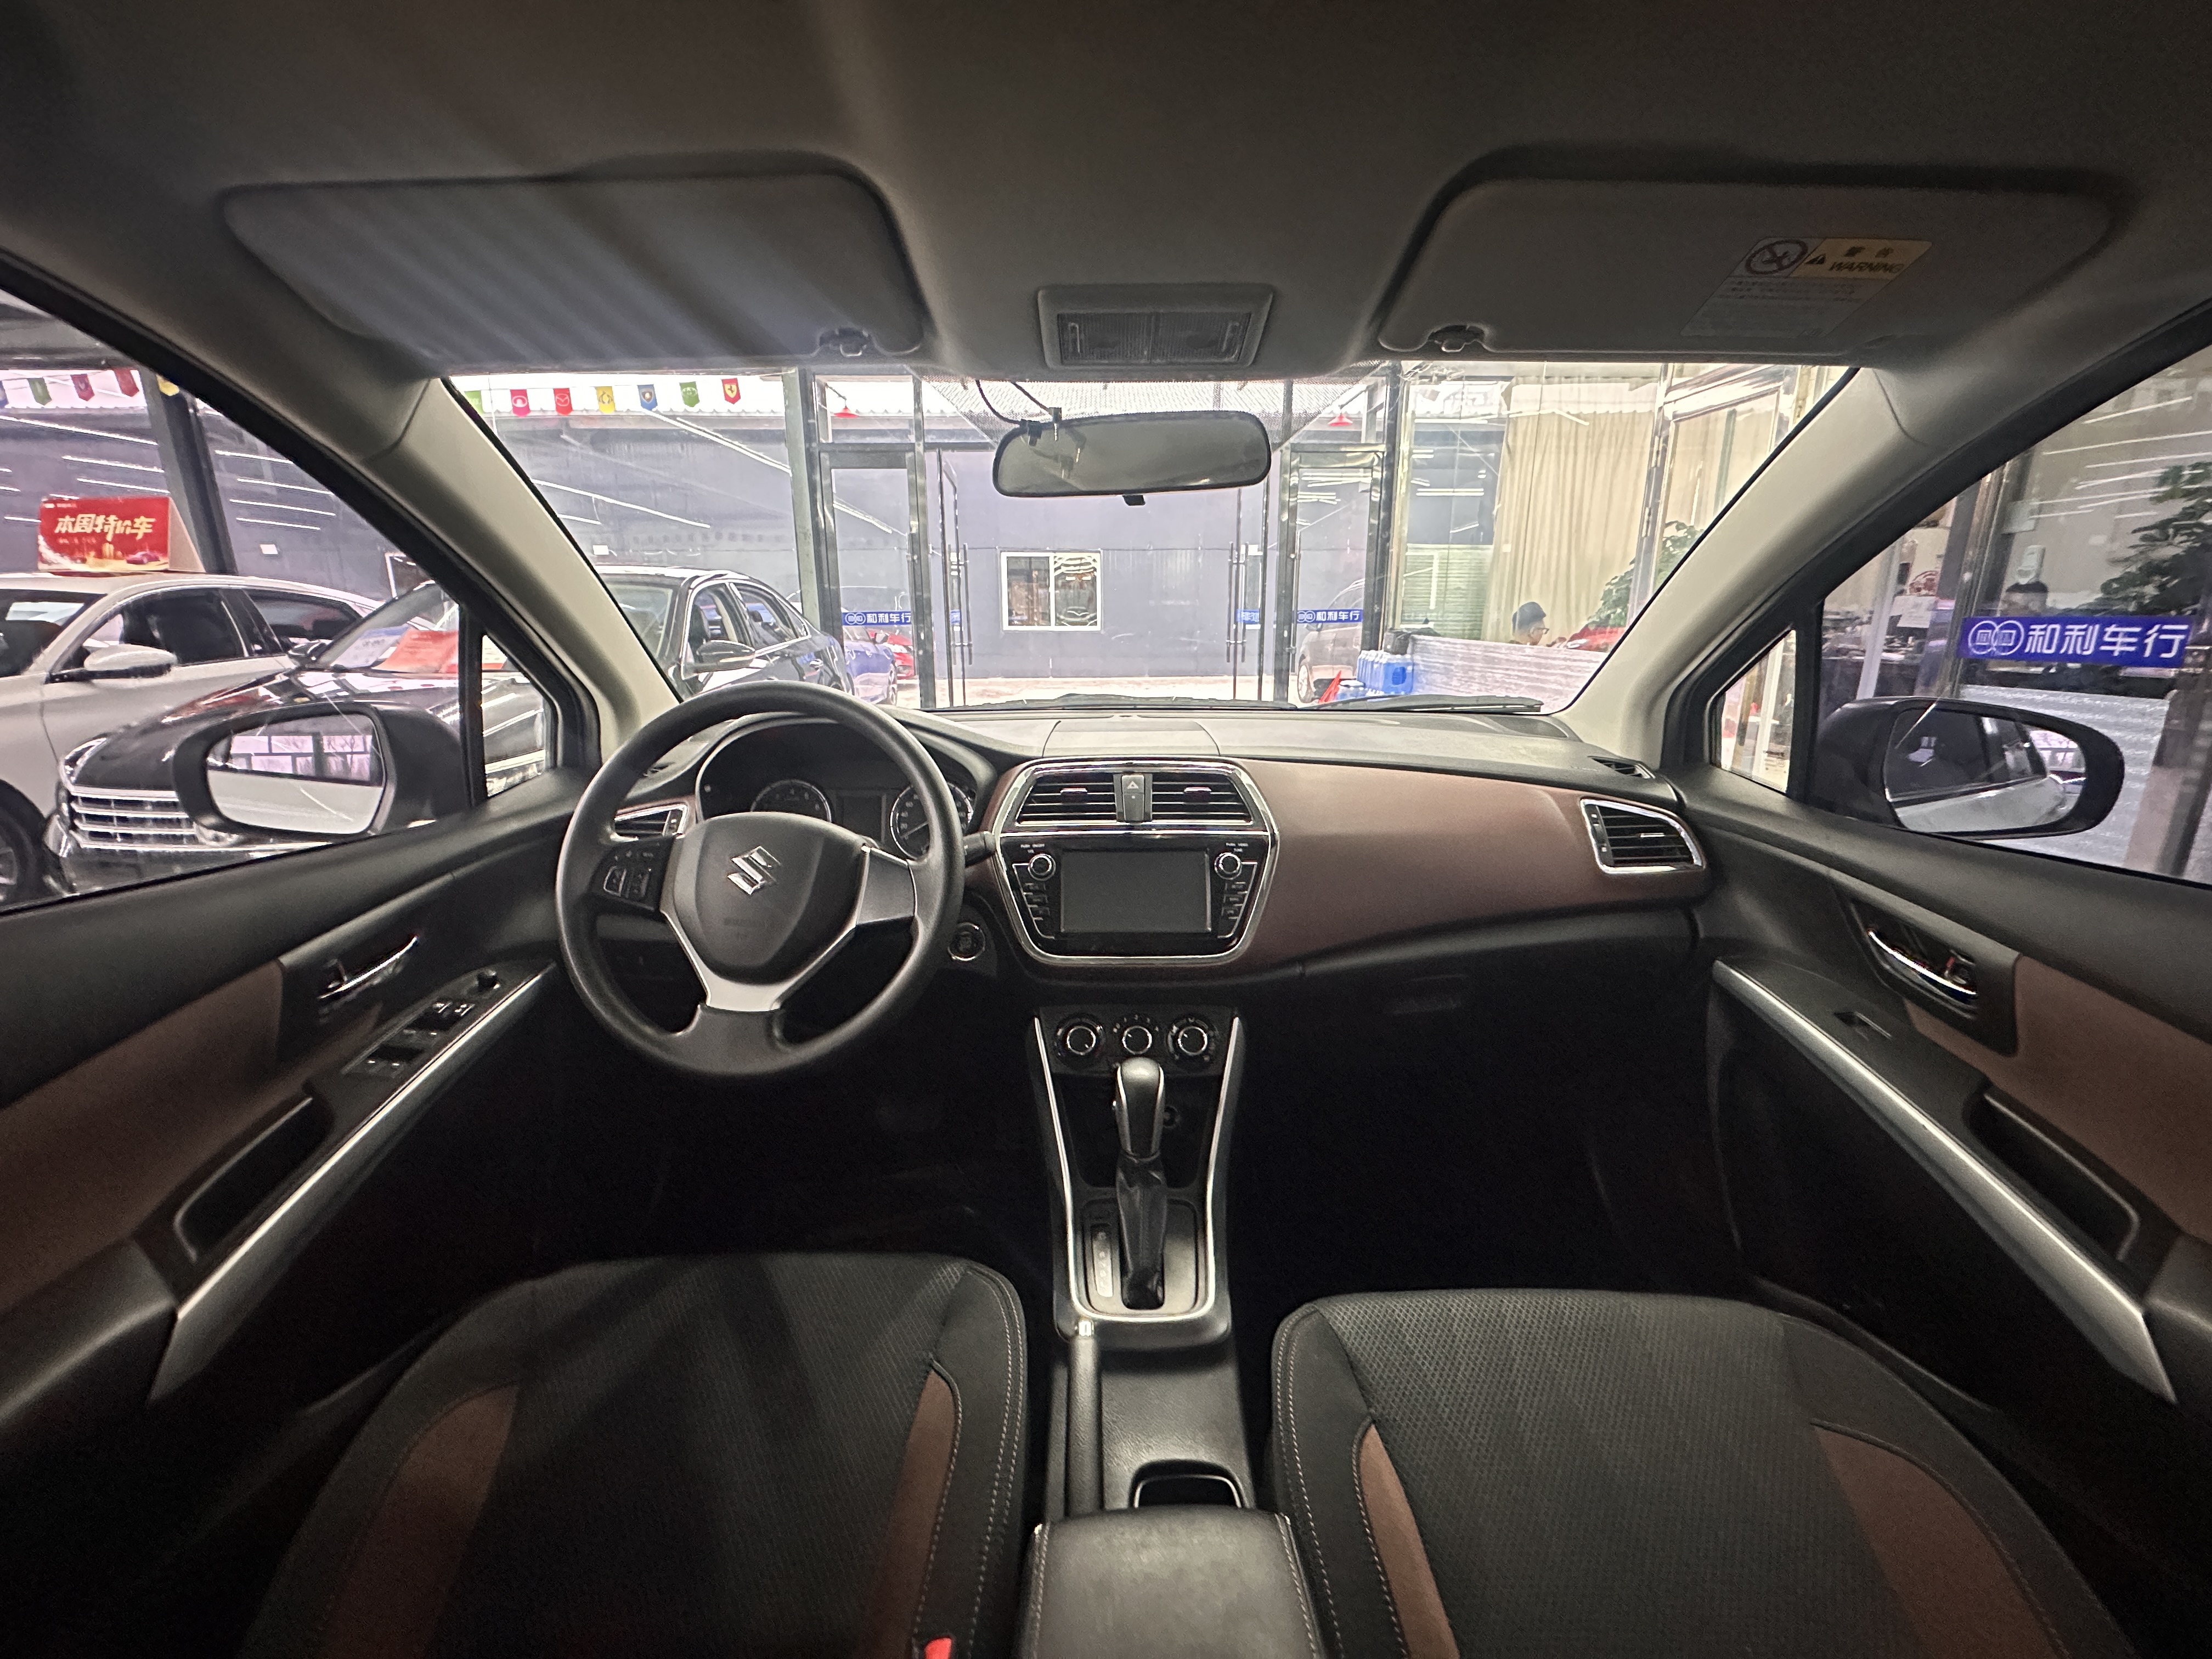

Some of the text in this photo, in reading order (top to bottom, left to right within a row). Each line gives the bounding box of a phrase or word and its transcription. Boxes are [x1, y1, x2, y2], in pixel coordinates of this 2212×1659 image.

[1829, 262, 1904, 274] WARNING
[867, 613, 911, 623] 和利车行
[1316, 611, 1359, 621] 和利车行
[2025, 623, 2188, 658] 和利车行
